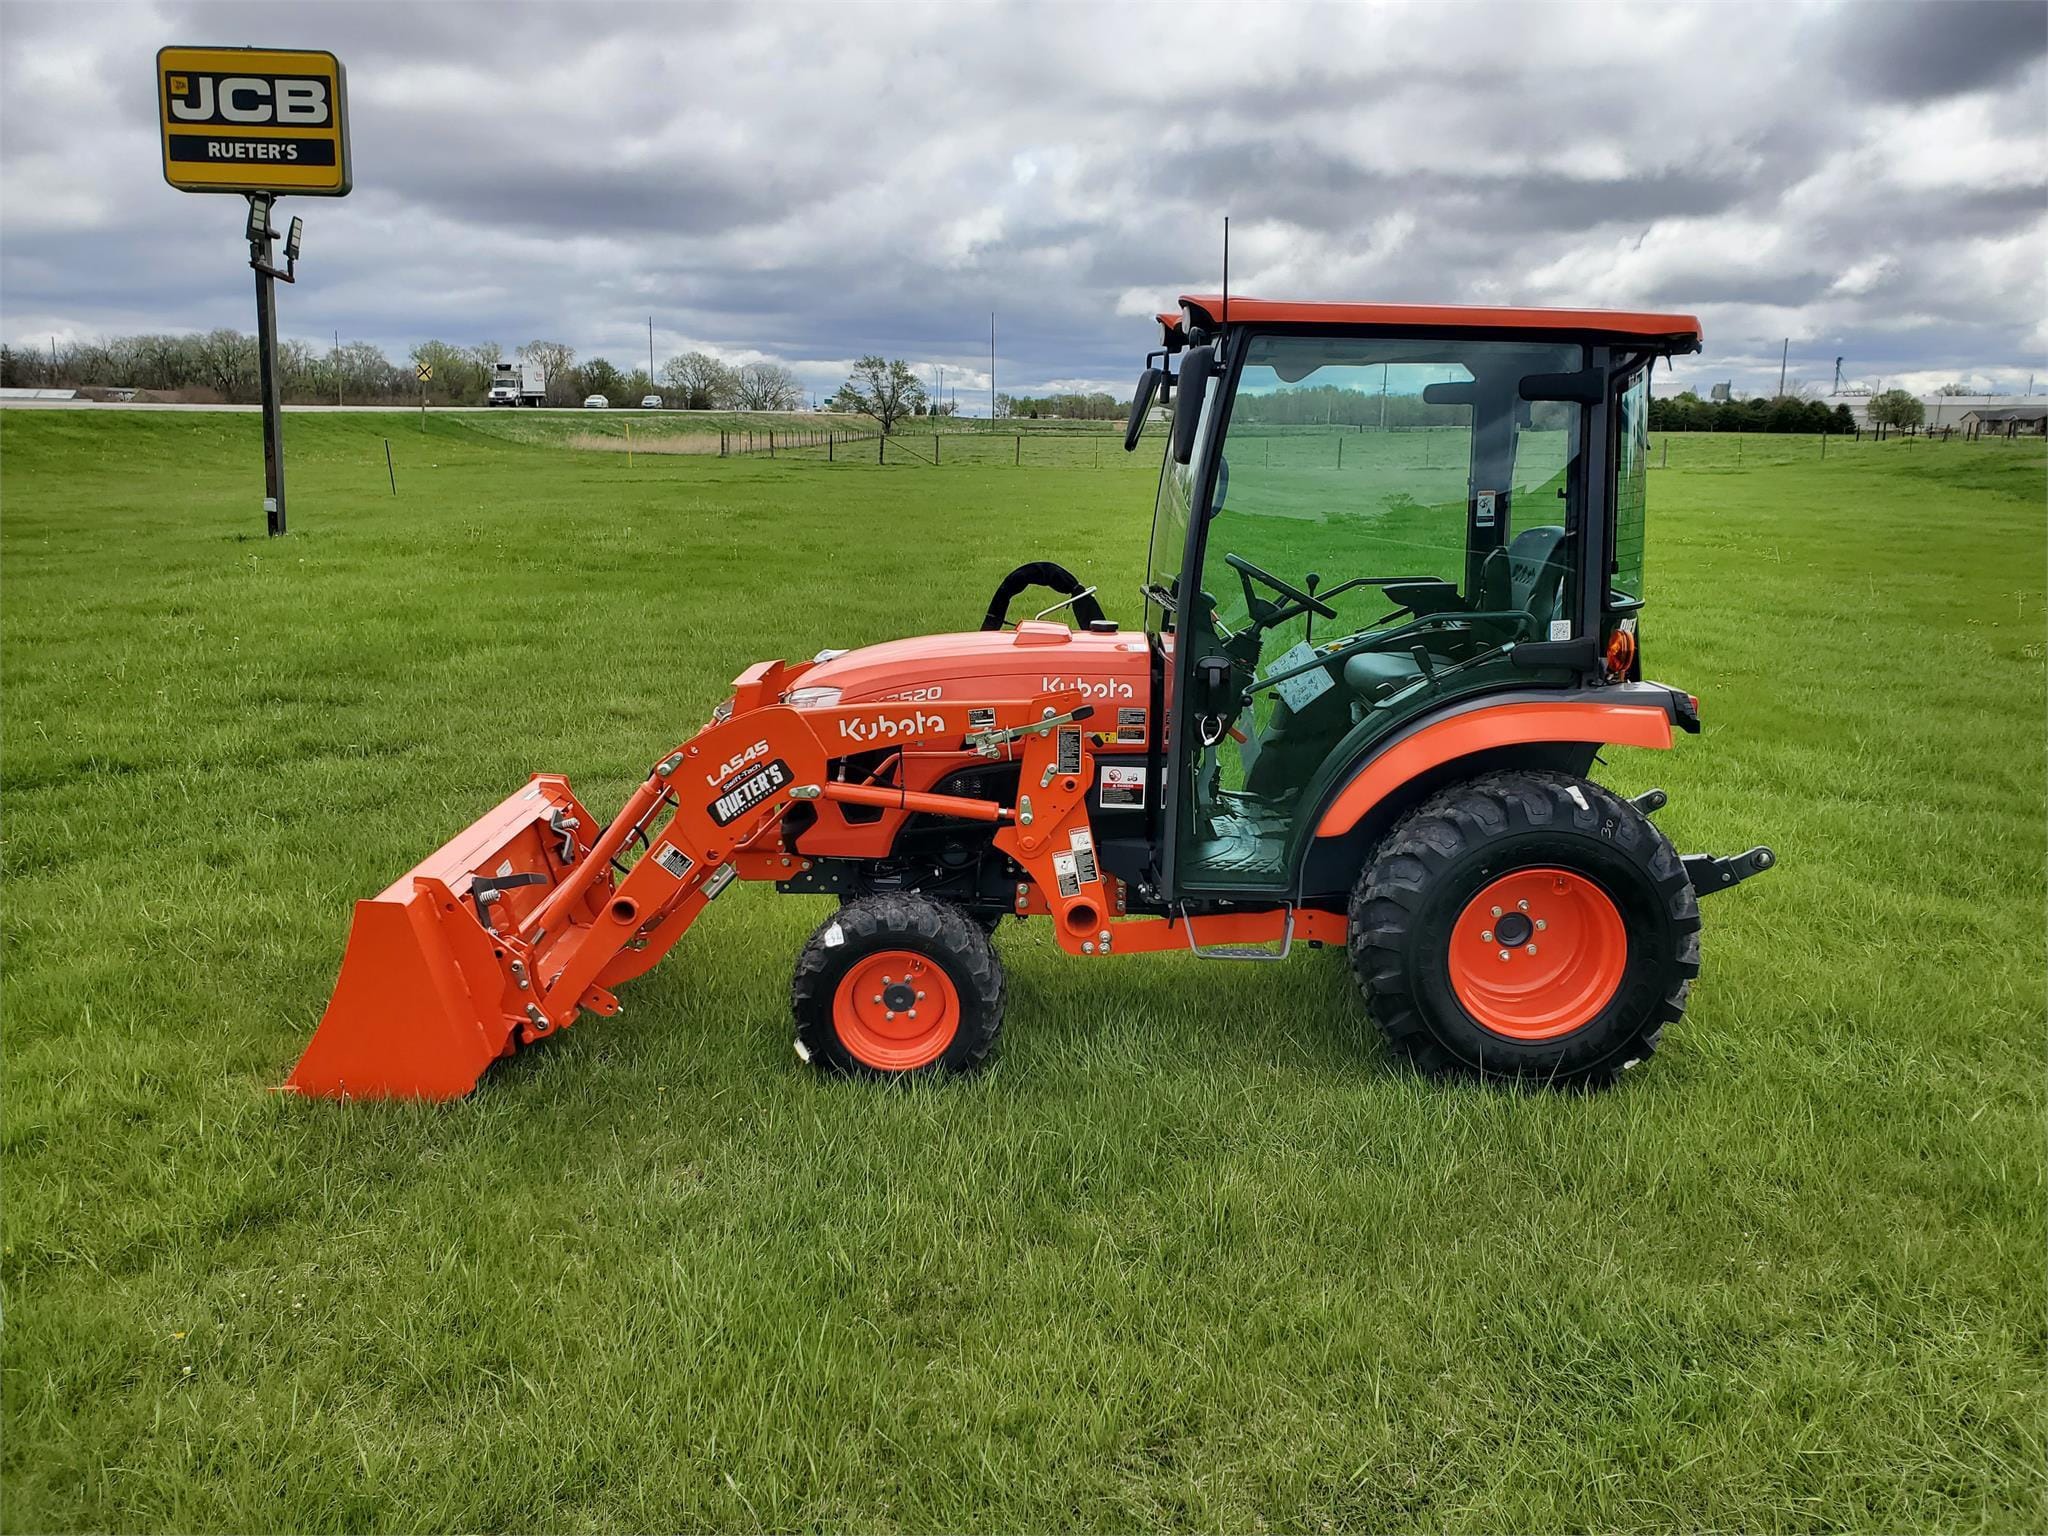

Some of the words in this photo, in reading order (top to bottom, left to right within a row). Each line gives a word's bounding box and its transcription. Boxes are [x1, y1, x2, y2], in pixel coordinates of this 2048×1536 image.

[172, 77, 329, 124] JCB
[207, 141, 299, 161] RUETER'S
[1042, 677, 1134, 699] Kubota
[838, 710, 946, 742] Kubota
[706, 739, 770, 787] LA545
[722, 763, 762, 791] Swift-Tach
[715, 763, 784, 822] RUETER'S
